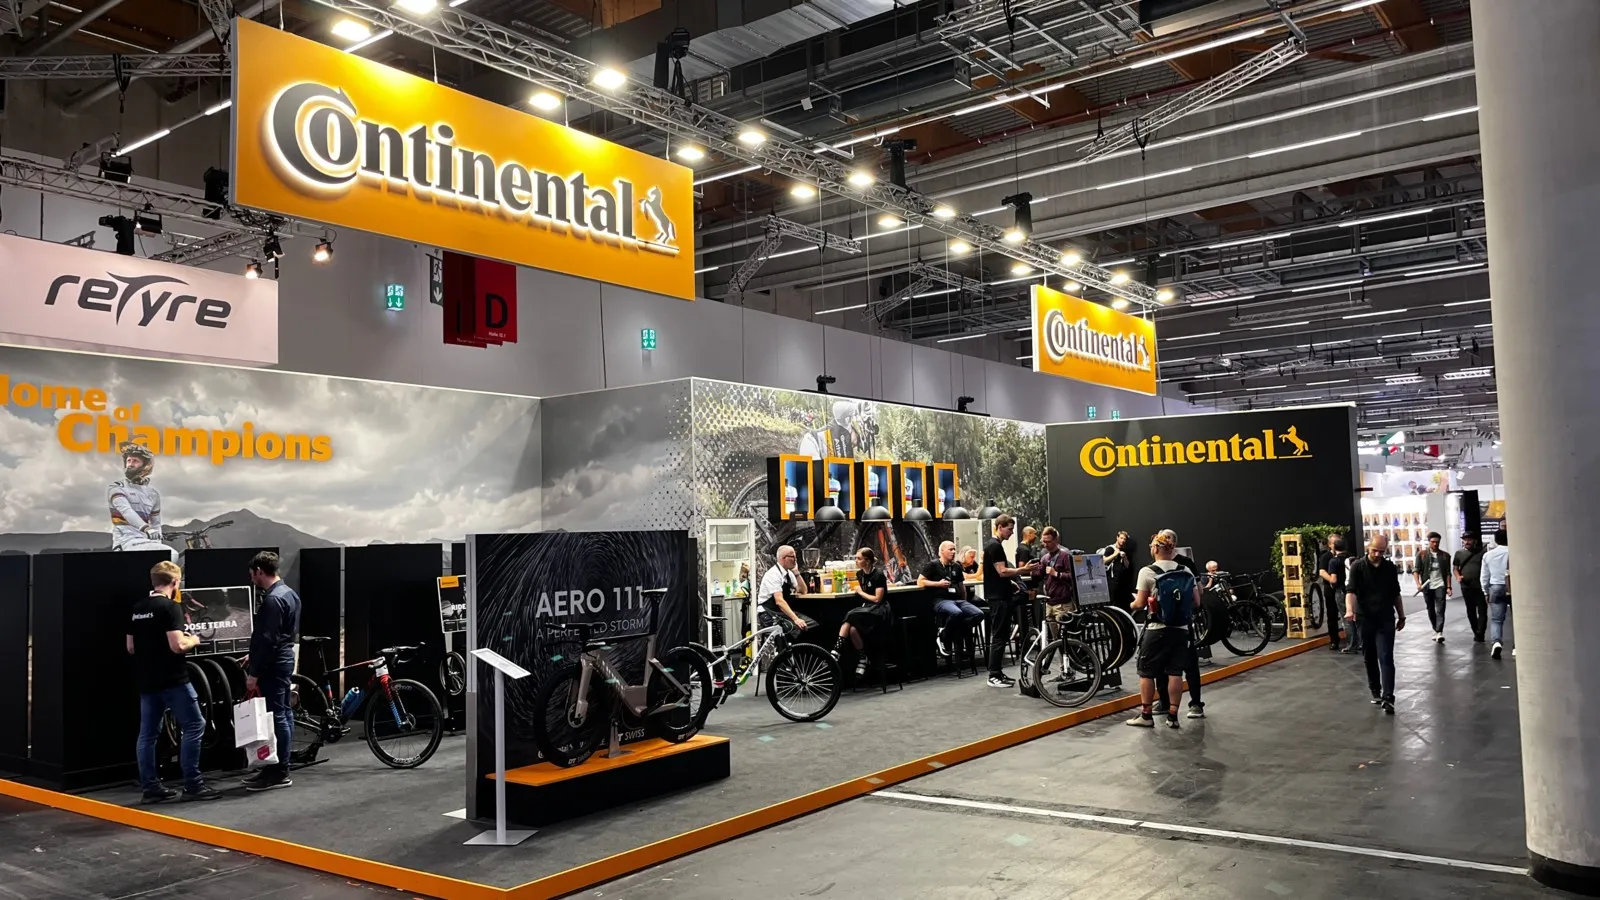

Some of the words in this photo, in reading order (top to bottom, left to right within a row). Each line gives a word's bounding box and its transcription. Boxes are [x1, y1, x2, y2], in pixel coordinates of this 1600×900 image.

[272, 82, 637, 240] Continental
[486, 293, 508, 329] D
[1047, 311, 1138, 365] Continental
[0, 373, 107, 412] ome
[114, 402, 142, 422] of
[57, 412, 332, 465] Champions
[1080, 430, 1277, 476] Continental
[536, 588, 605, 618] AERO
[613, 586, 643, 611] 111
[208, 620, 238, 630] TERRA
[536, 628, 544, 640] A
[610, 619, 644, 632] STORM
[617, 733, 623, 742] T
[624, 728, 645, 740] SWISS
